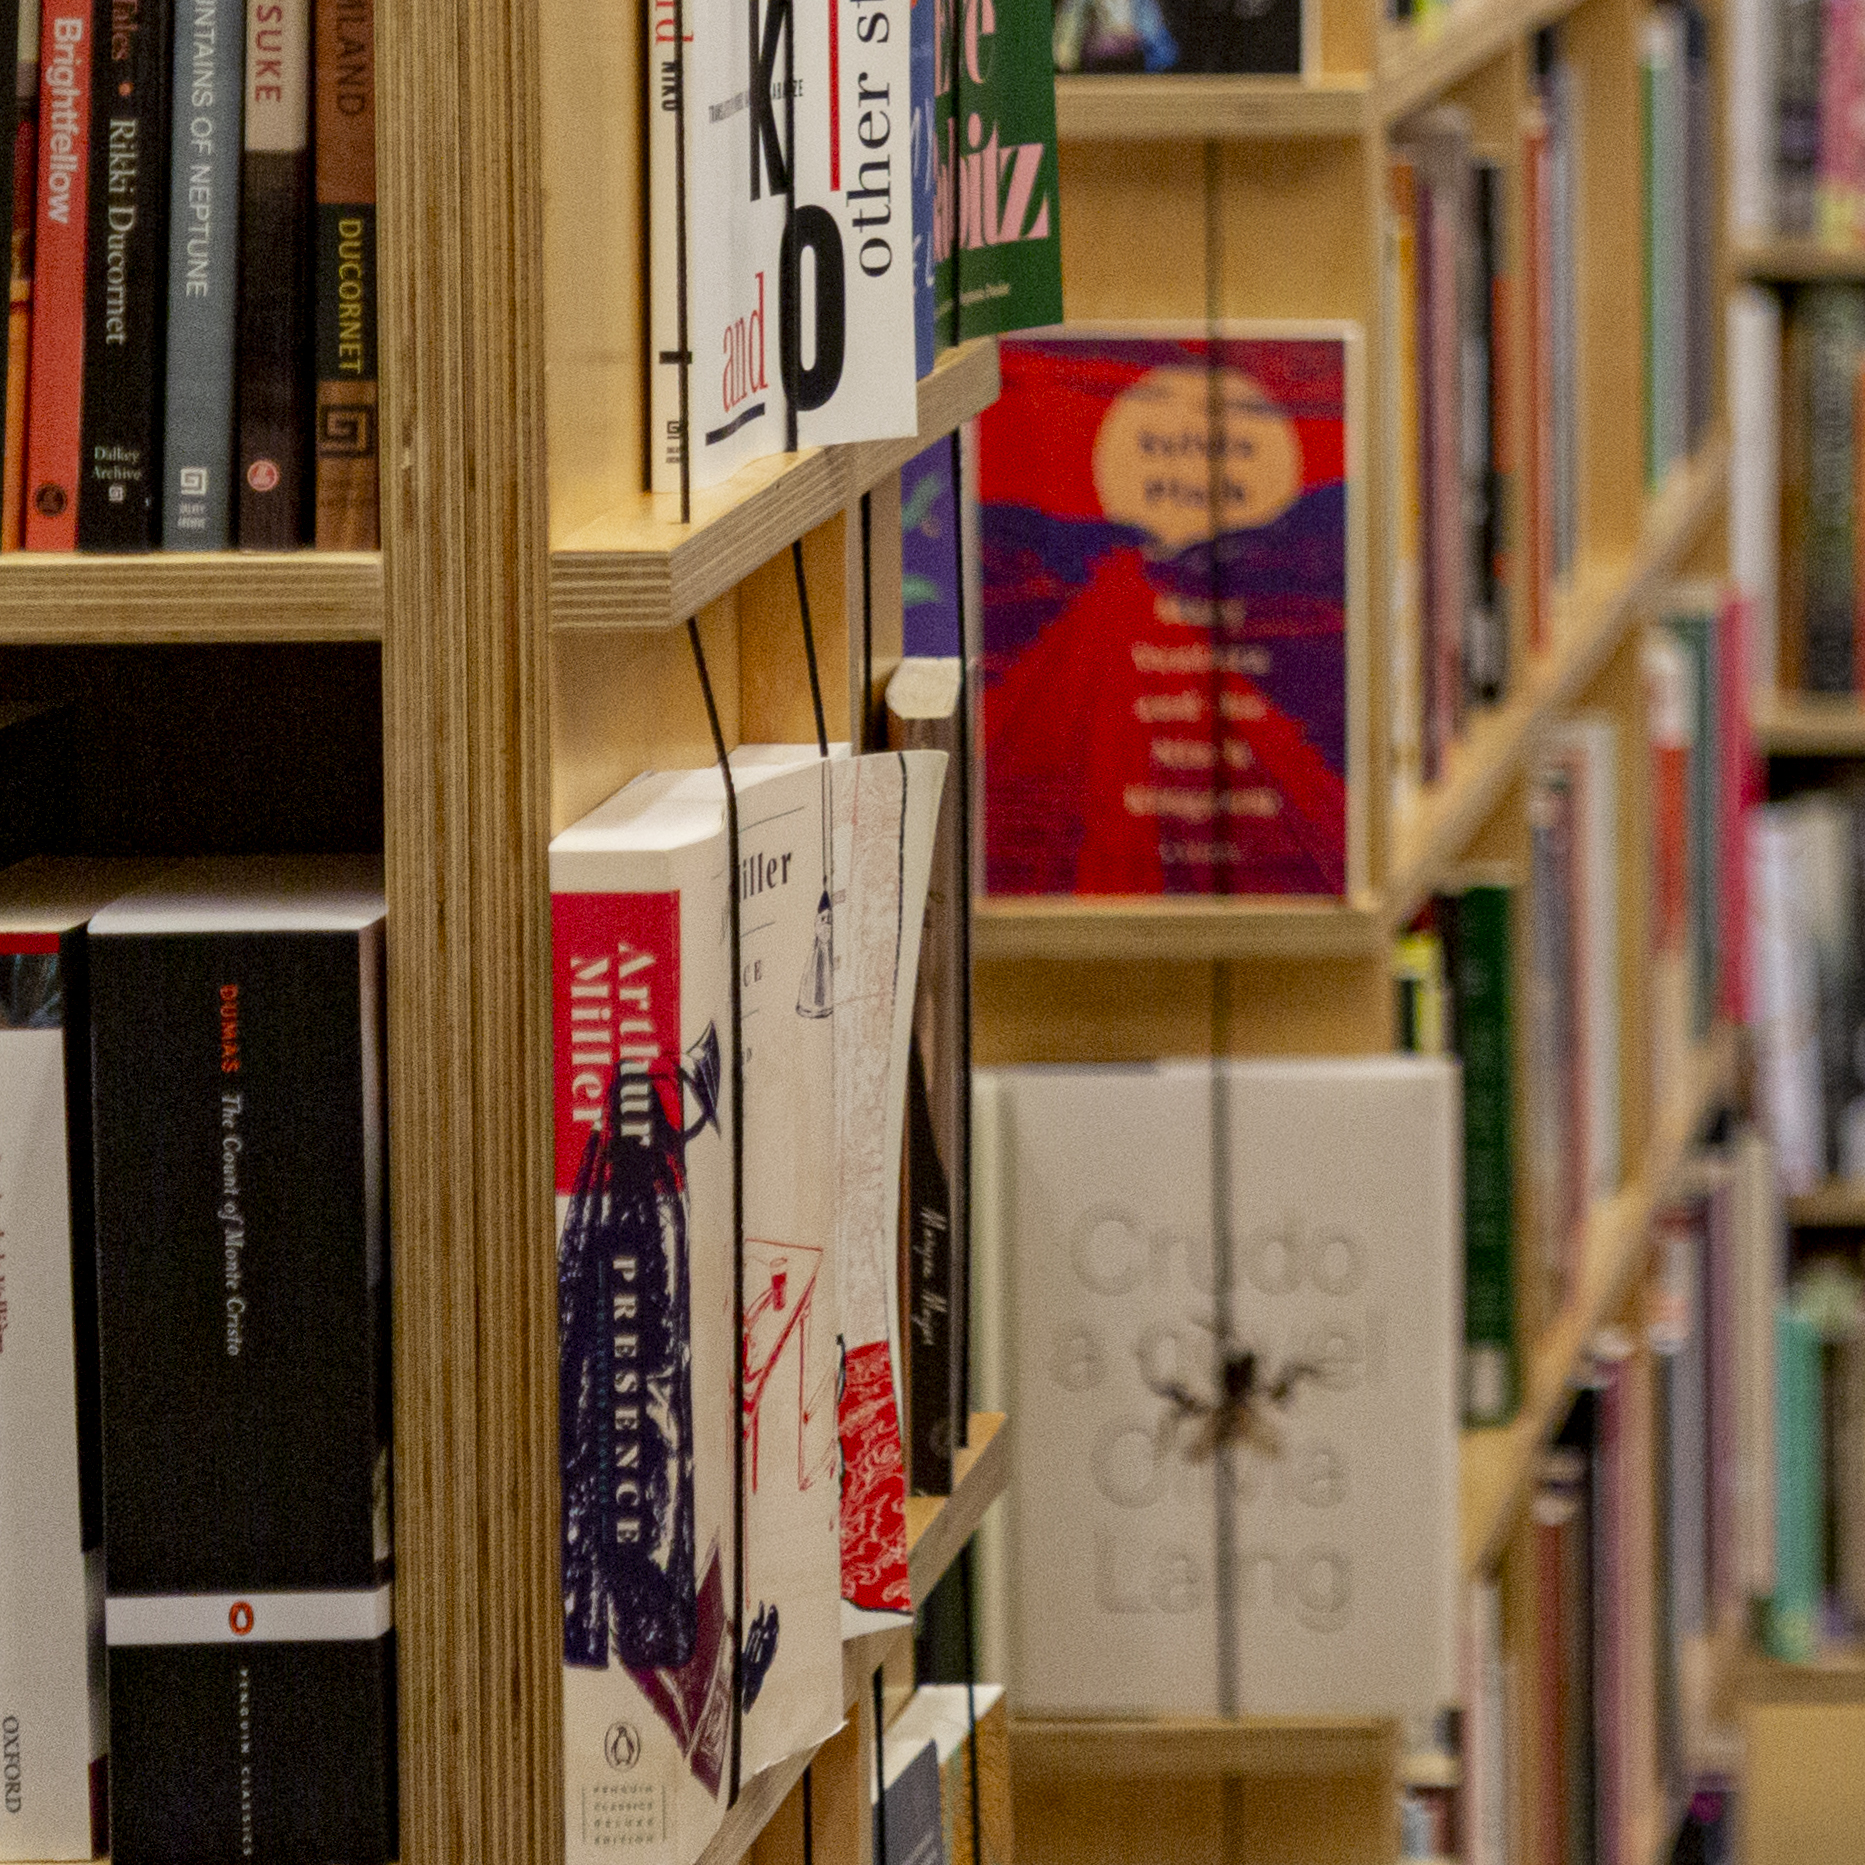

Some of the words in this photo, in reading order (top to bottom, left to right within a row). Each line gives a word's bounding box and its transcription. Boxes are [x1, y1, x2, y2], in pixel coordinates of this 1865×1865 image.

[46, 16, 84, 225] Brightfellow
[107, 118, 139, 195] Rikki
[189, 117, 213, 155] OF
[846, 71, 893, 279] other
[105, 205, 137, 346] Ducornet
[185, 165, 213, 298] NEPTUNE
[337, 218, 364, 375] DUCORNET
[721, 270, 770, 414] and
[92, 464, 143, 482] Archive
[93, 445, 141, 464] Dalkey
[741, 851, 793, 901] iller
[219, 983, 241, 1074] DUMAS
[570, 958, 611, 1133] Miller
[617, 941, 660, 1147] Arthur
[221, 1093, 243, 1129] The
[221, 1136, 243, 1195] Count
[217, 1200, 245, 1226] of
[224, 1226, 246, 1290] Monte
[226, 1297, 247, 1358] Cristo
[611, 1254, 640, 1546] PRESENCE
[1, 1715, 21, 1815] OXFORD
[240, 1766, 253, 1858] CLASSICS
